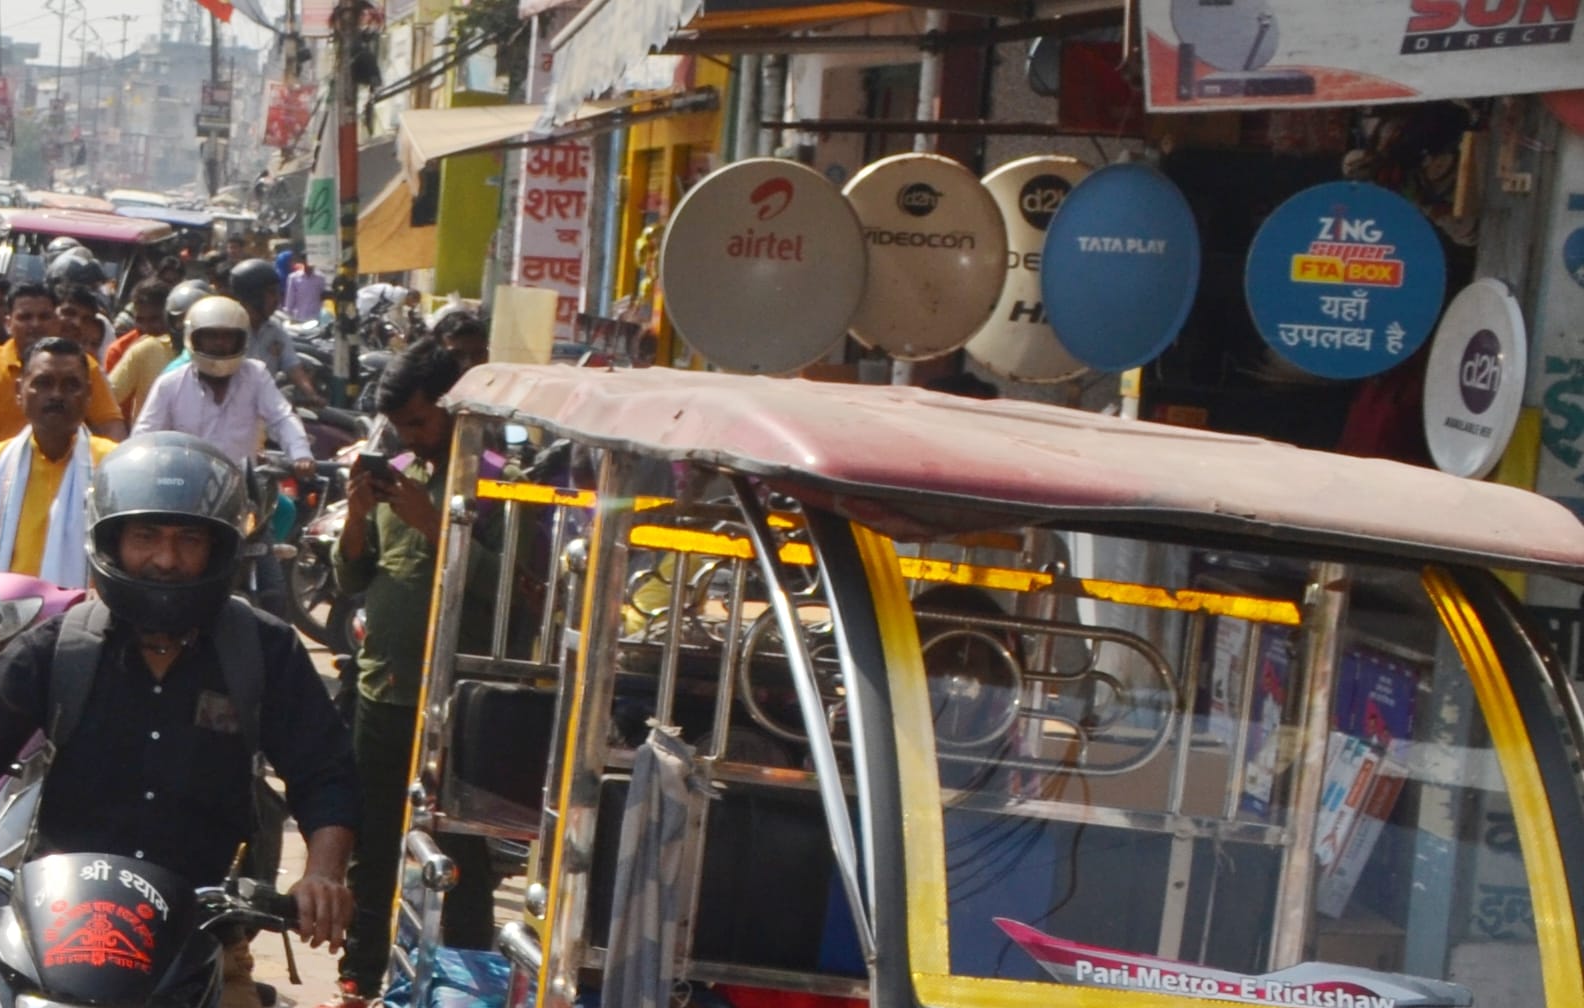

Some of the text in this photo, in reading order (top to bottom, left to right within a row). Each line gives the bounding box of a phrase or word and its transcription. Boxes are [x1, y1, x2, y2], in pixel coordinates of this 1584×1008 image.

[1415, 27, 1561, 51] DIRECT
[727, 228, 803, 262] airtel
[1077, 236, 1166, 254] TATA PLAY
[1318, 216, 1383, 242] ZING
[1301, 261, 1393, 280] FTA BOX
[1320, 288, 1370, 321] यहाँ
[1278, 321, 1406, 354] उपलब्ध है
[1462, 353, 1500, 391] d2h
[1075, 960, 1129, 986] Pari
[1138, 966, 1218, 995] Metro
[1239, 977, 1256, 998] E
